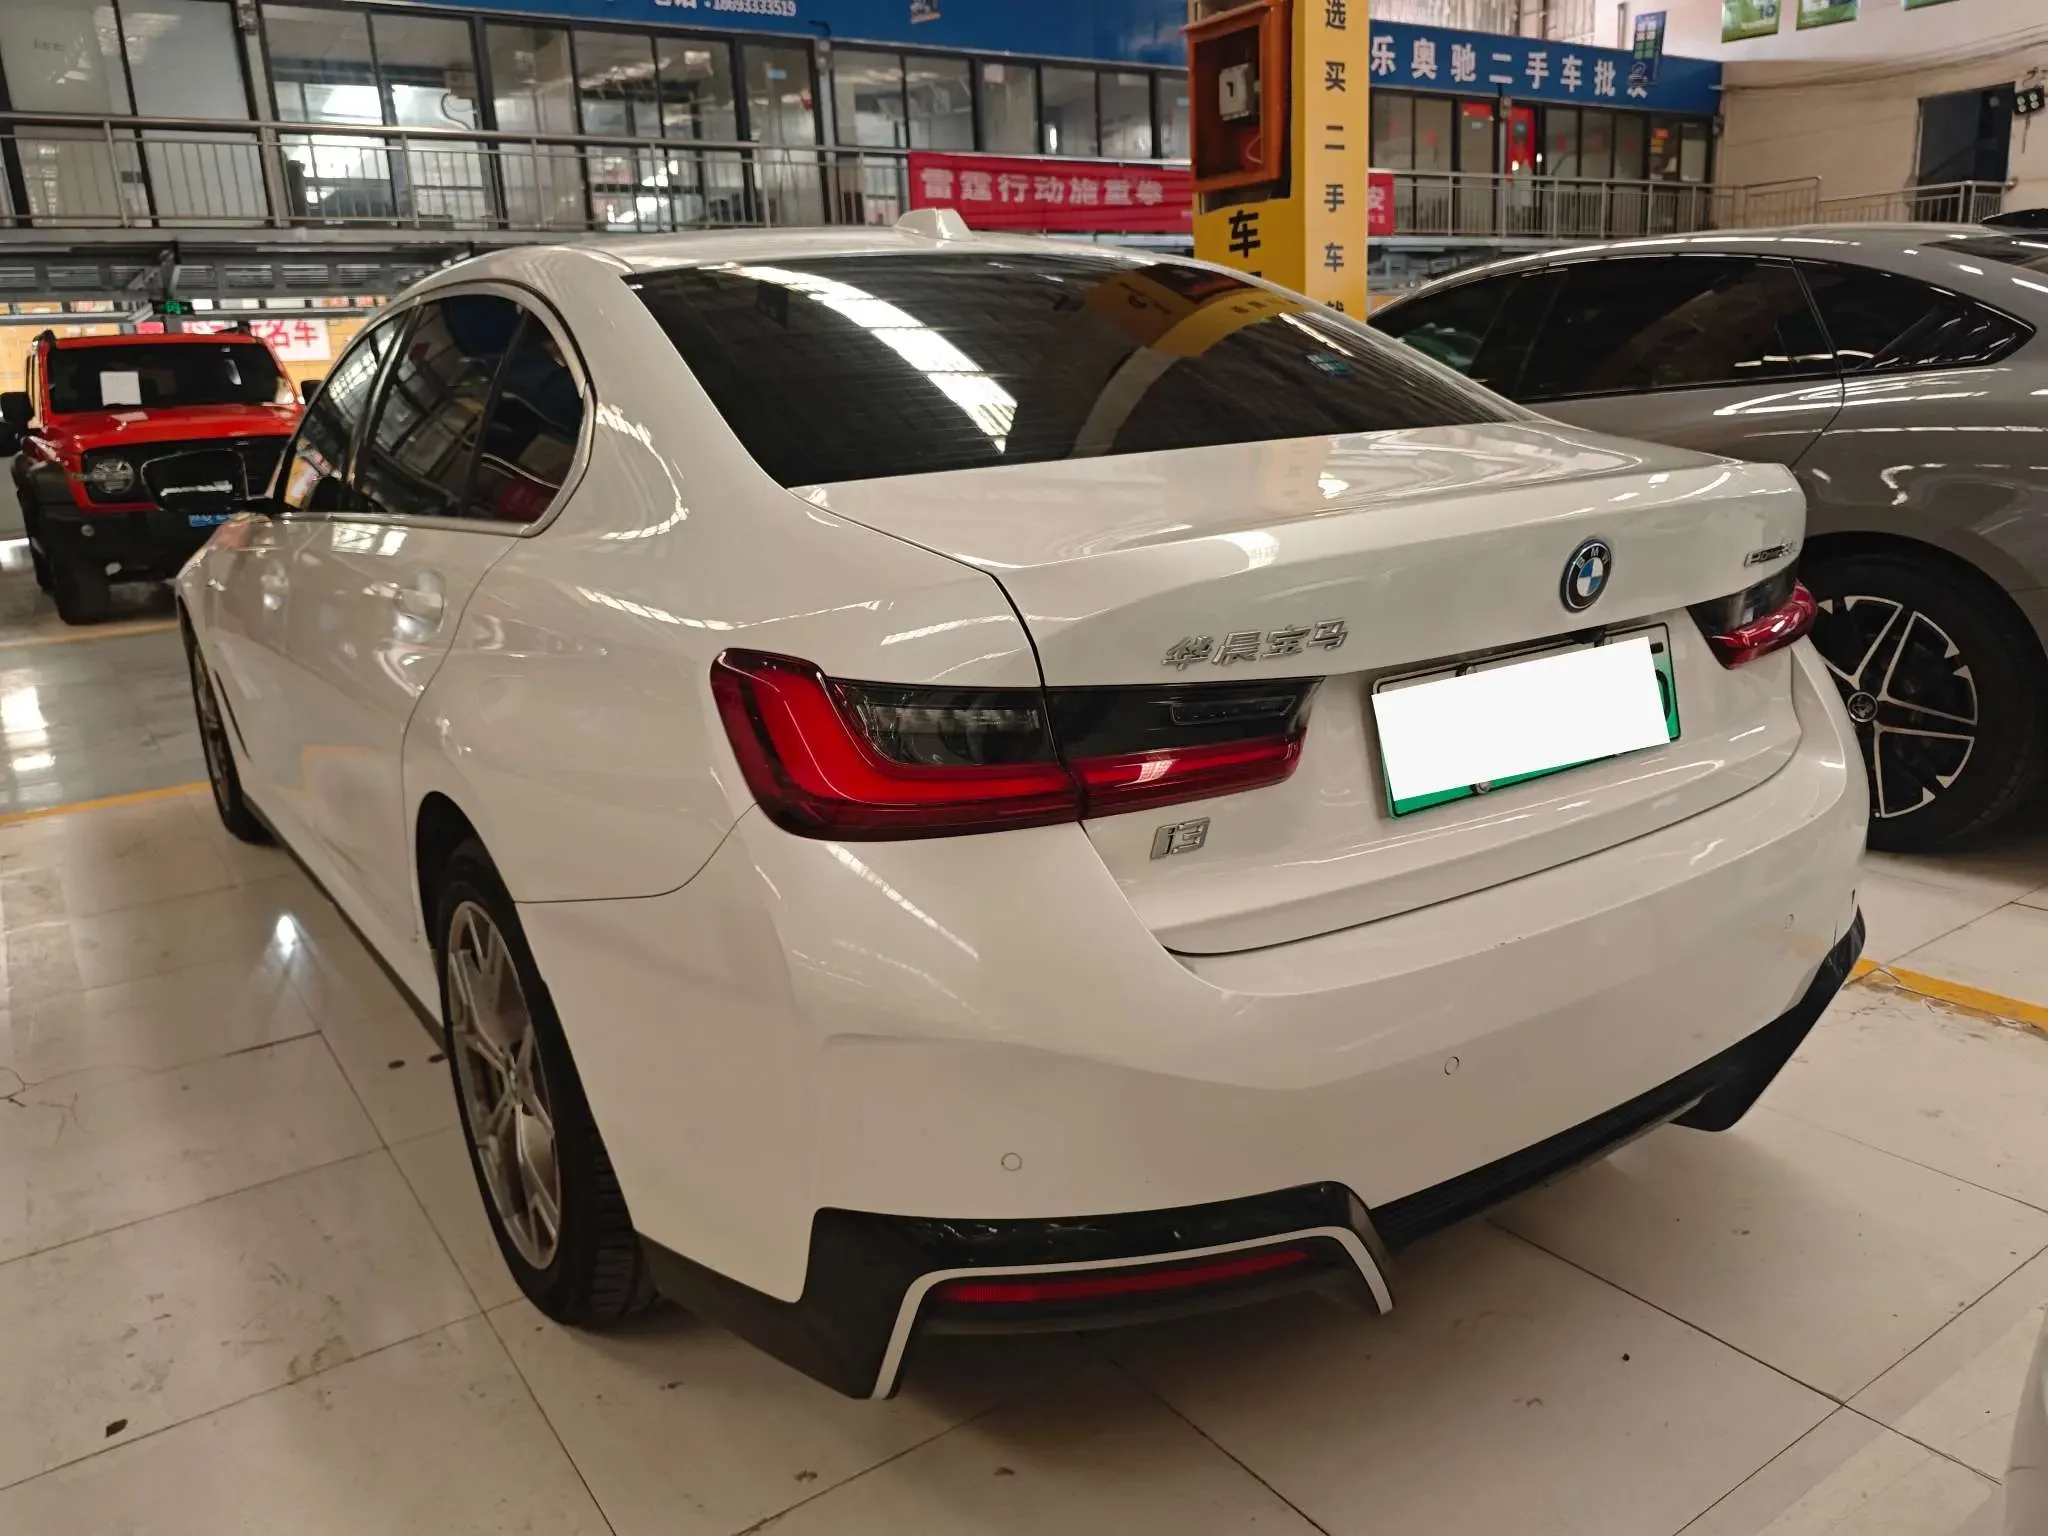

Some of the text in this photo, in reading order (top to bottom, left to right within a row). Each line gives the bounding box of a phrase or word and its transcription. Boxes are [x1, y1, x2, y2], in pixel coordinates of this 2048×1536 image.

[1229, 210, 1262, 278] 车
[1161, 618, 1349, 671] 华晨宝马
